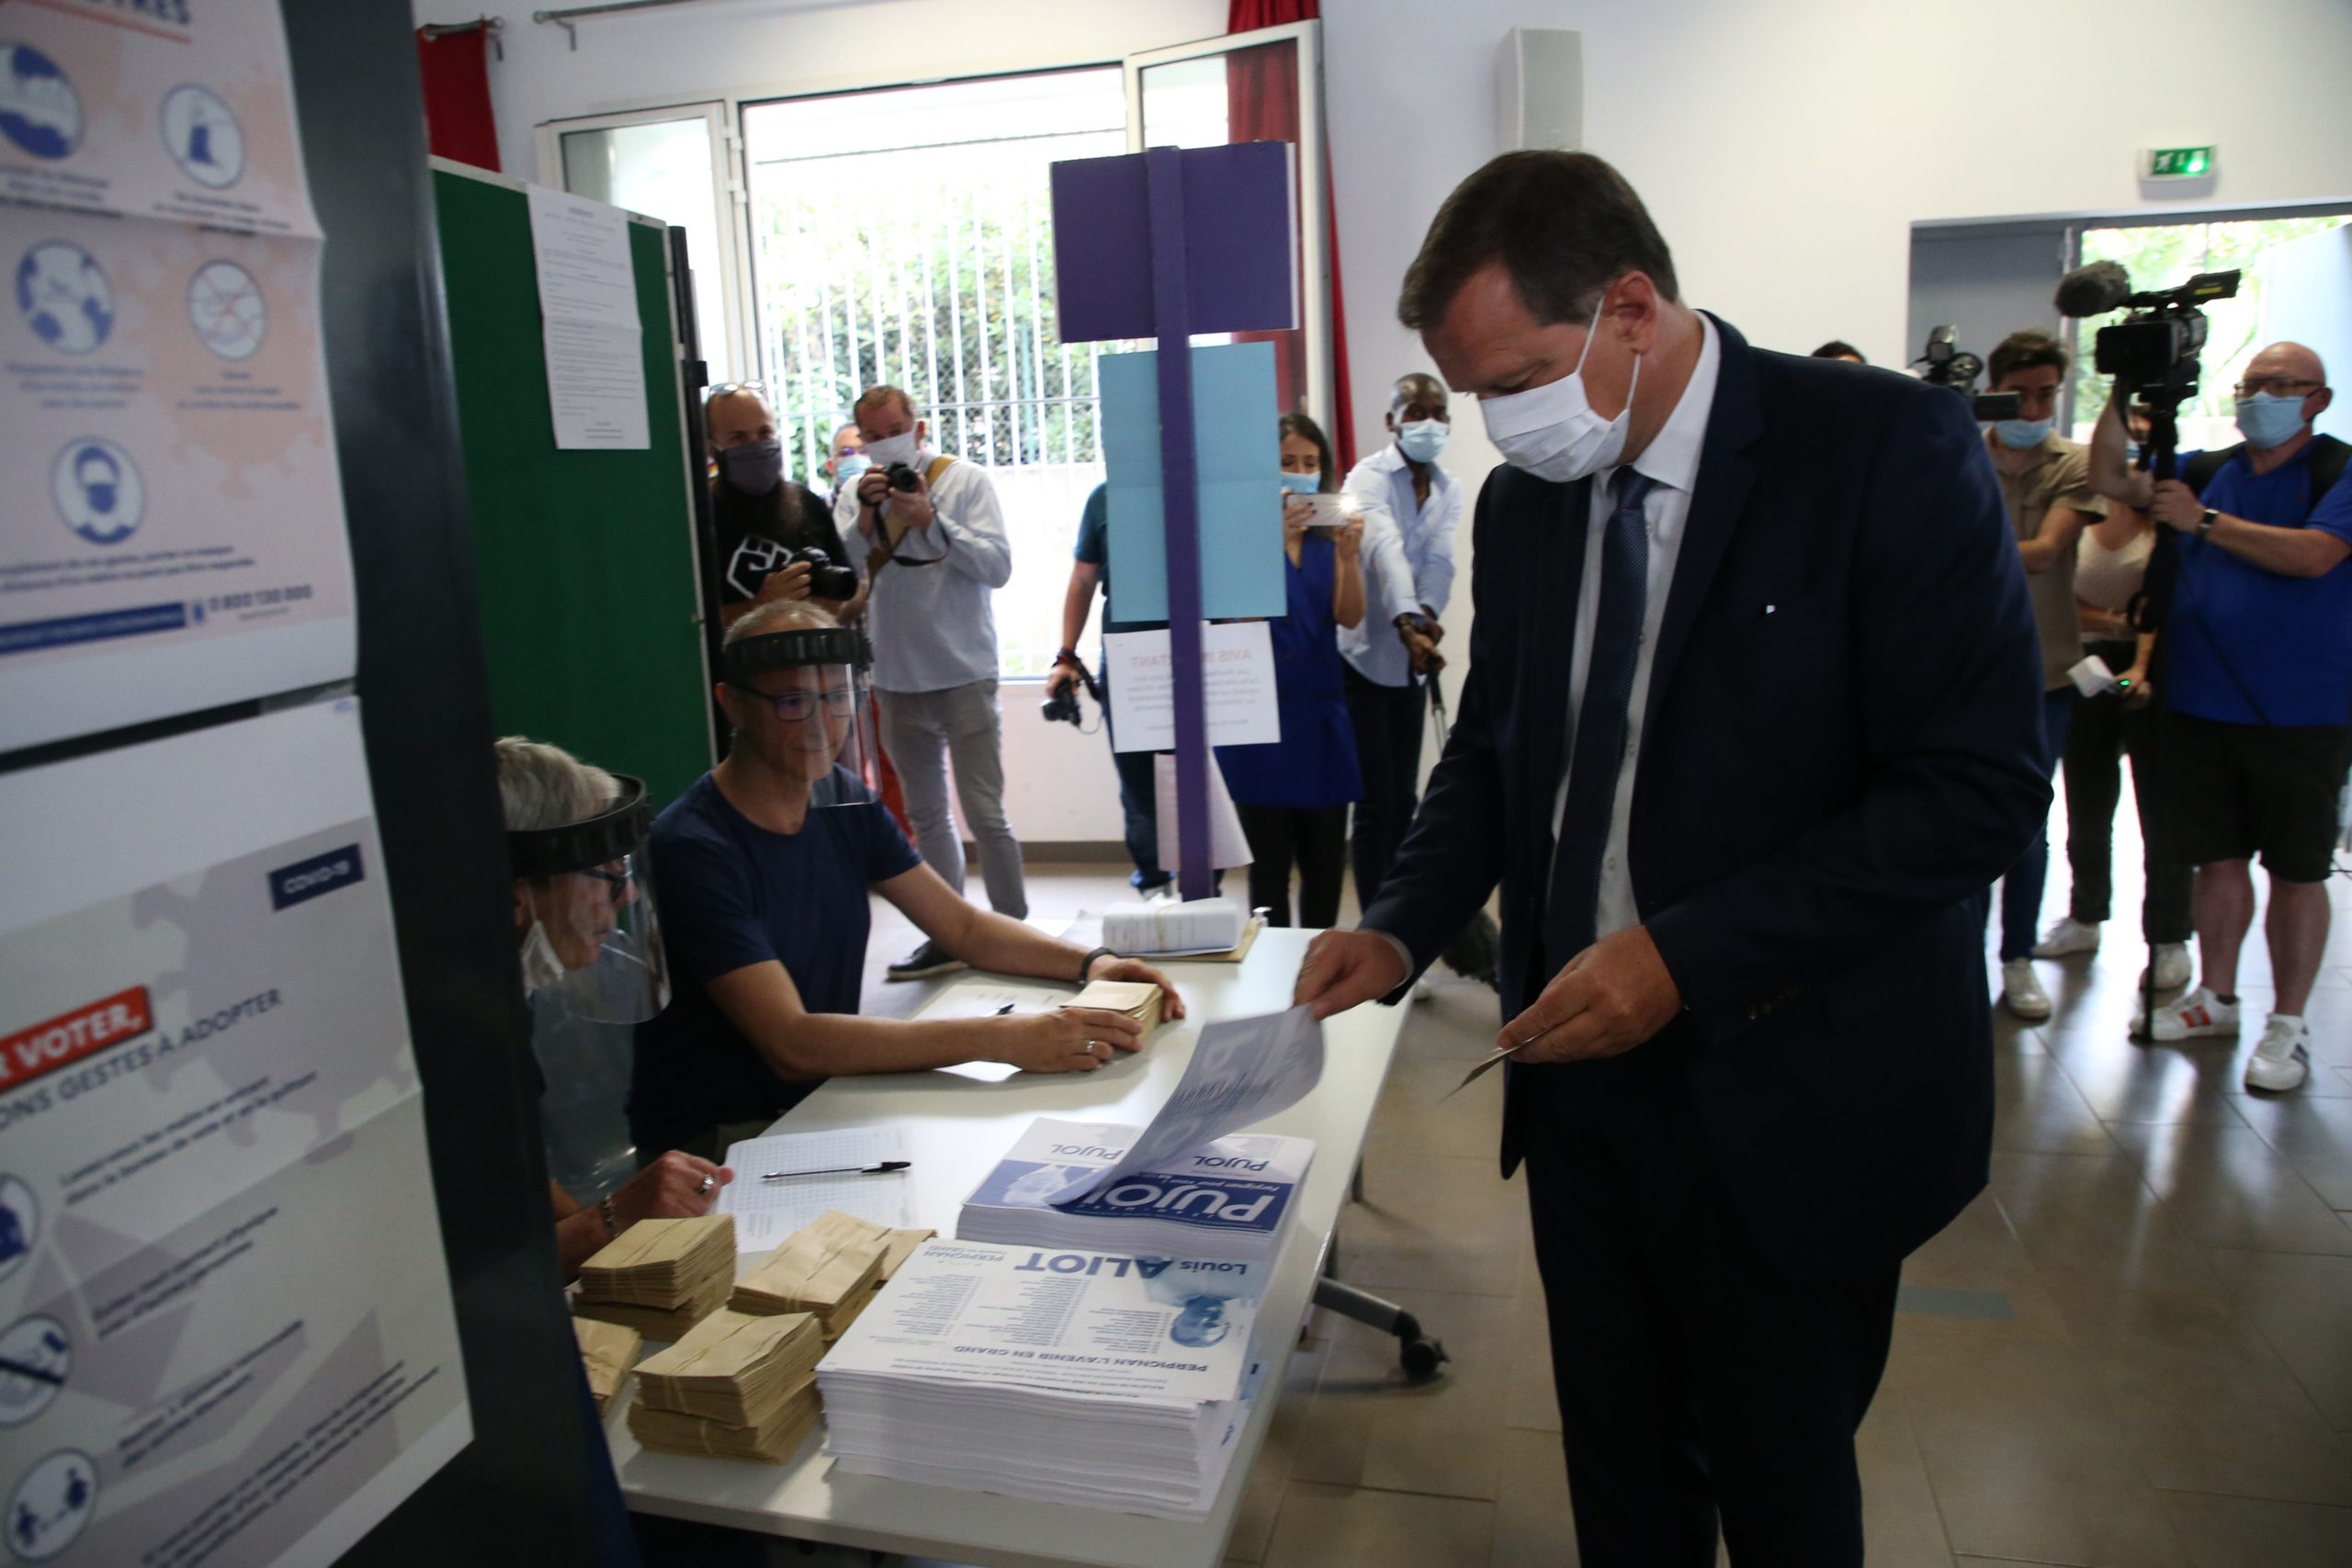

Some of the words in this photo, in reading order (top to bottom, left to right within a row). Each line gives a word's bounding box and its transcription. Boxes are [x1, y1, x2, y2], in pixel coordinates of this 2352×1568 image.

[57, 1043, 153, 1100] GESTES
[181, 987, 282, 1045] ADOPTER
[1050, 1144, 1125, 1160] PUJOL
[1193, 1156, 1271, 1172] PUJOL
[1013, 1252, 1175, 1280] ALIOT
[1179, 1260, 1248, 1275] Louis
[954, 1345, 1009, 1357] GRAND
[1011, 1349, 1035, 1359] EN
[1038, 1352, 1110, 1365] L'AVENIR
[1113, 1358, 1209, 1372] PERPIGNAN
